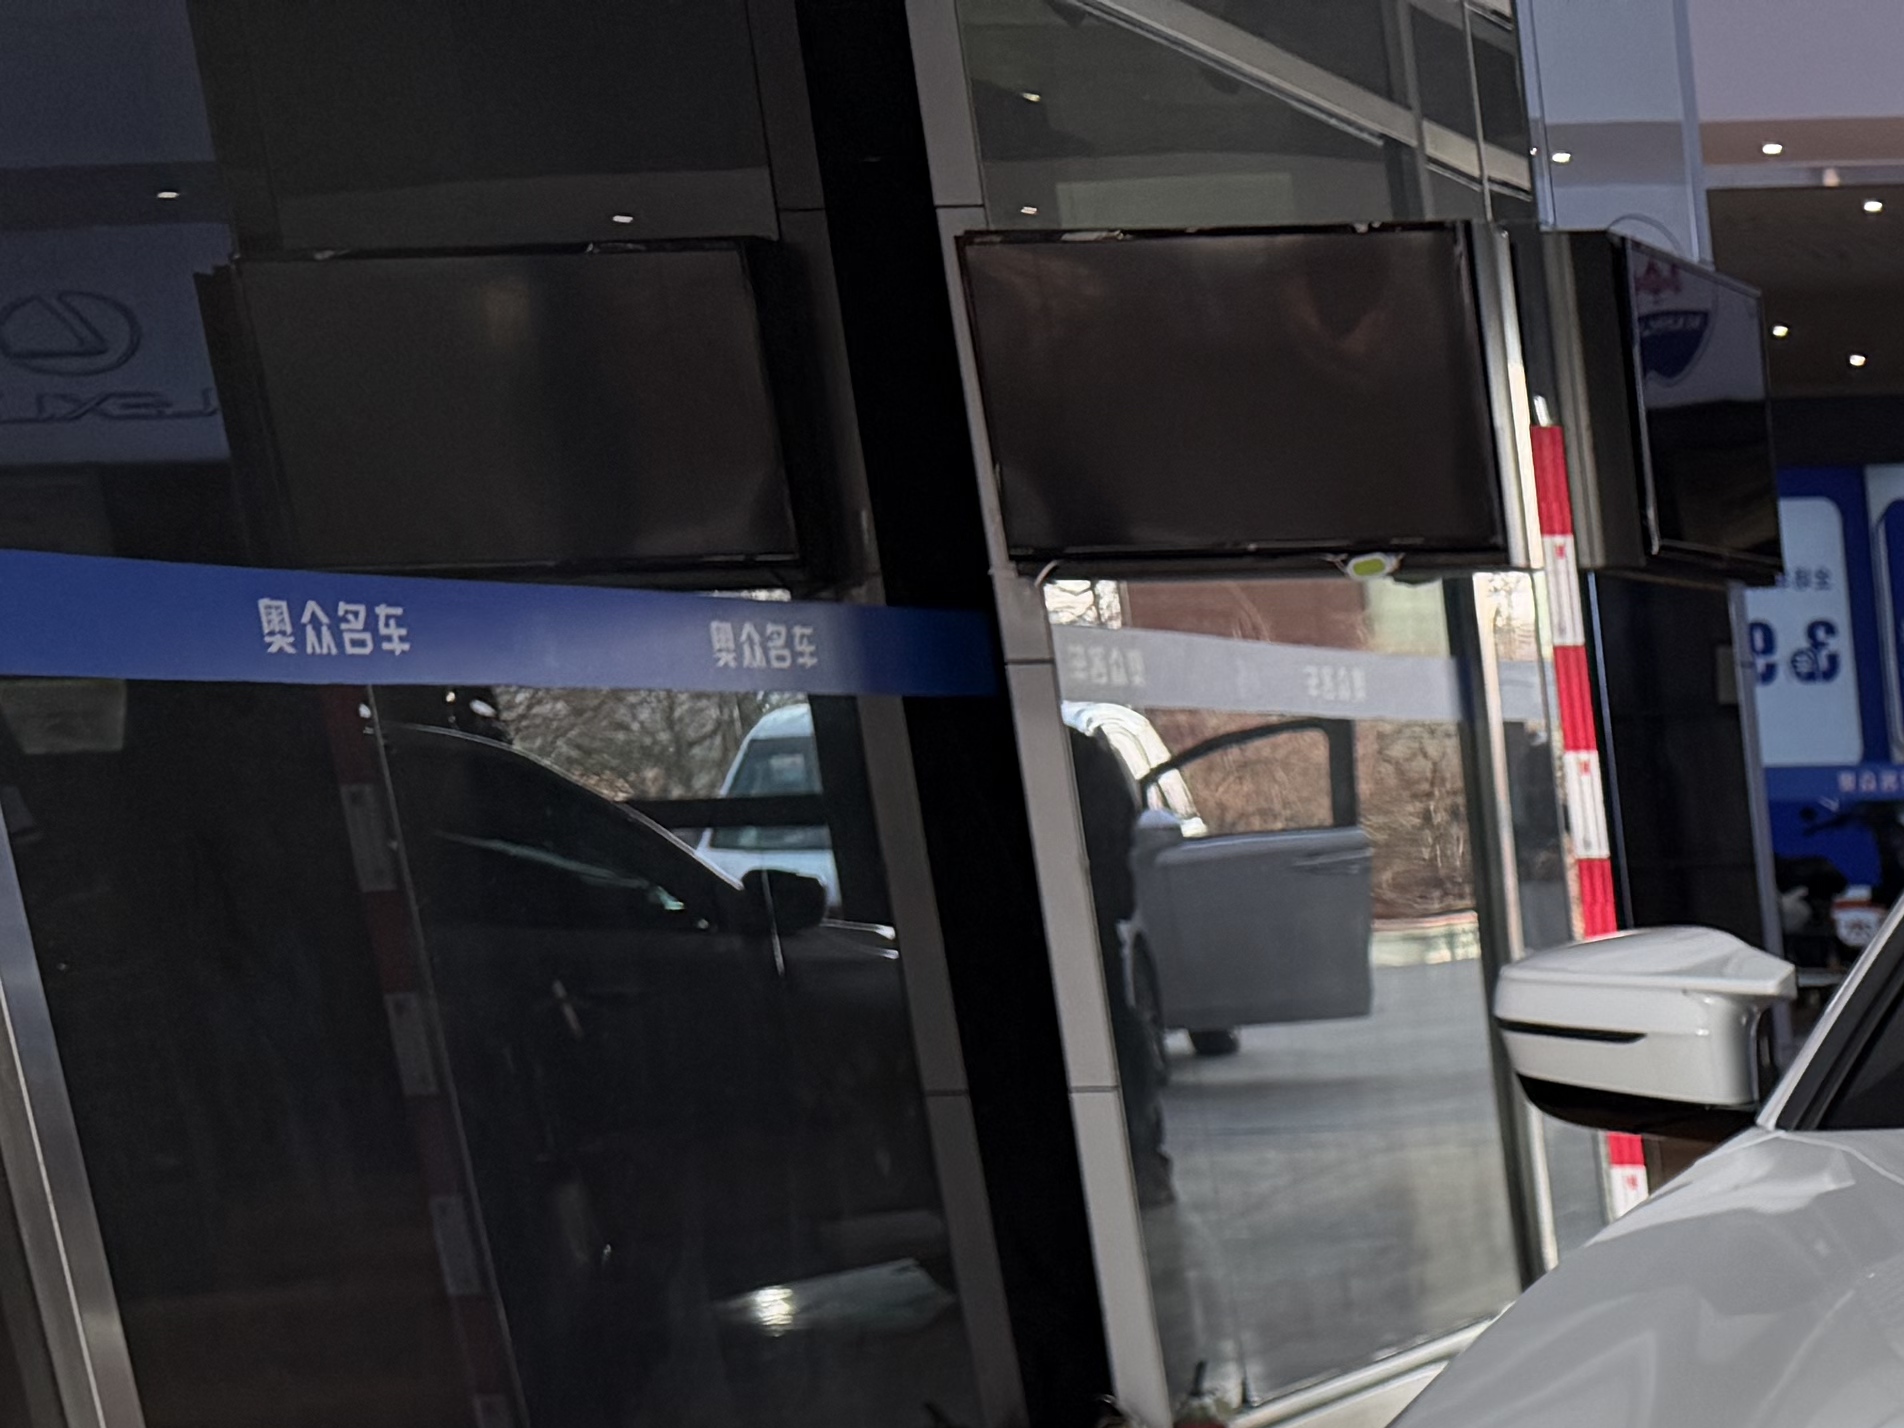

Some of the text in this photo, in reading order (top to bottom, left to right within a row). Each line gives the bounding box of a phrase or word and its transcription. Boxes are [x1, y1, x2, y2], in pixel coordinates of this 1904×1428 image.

[258, 597, 411, 655] 奥众名车
[709, 620, 818, 669] 奥众名车
